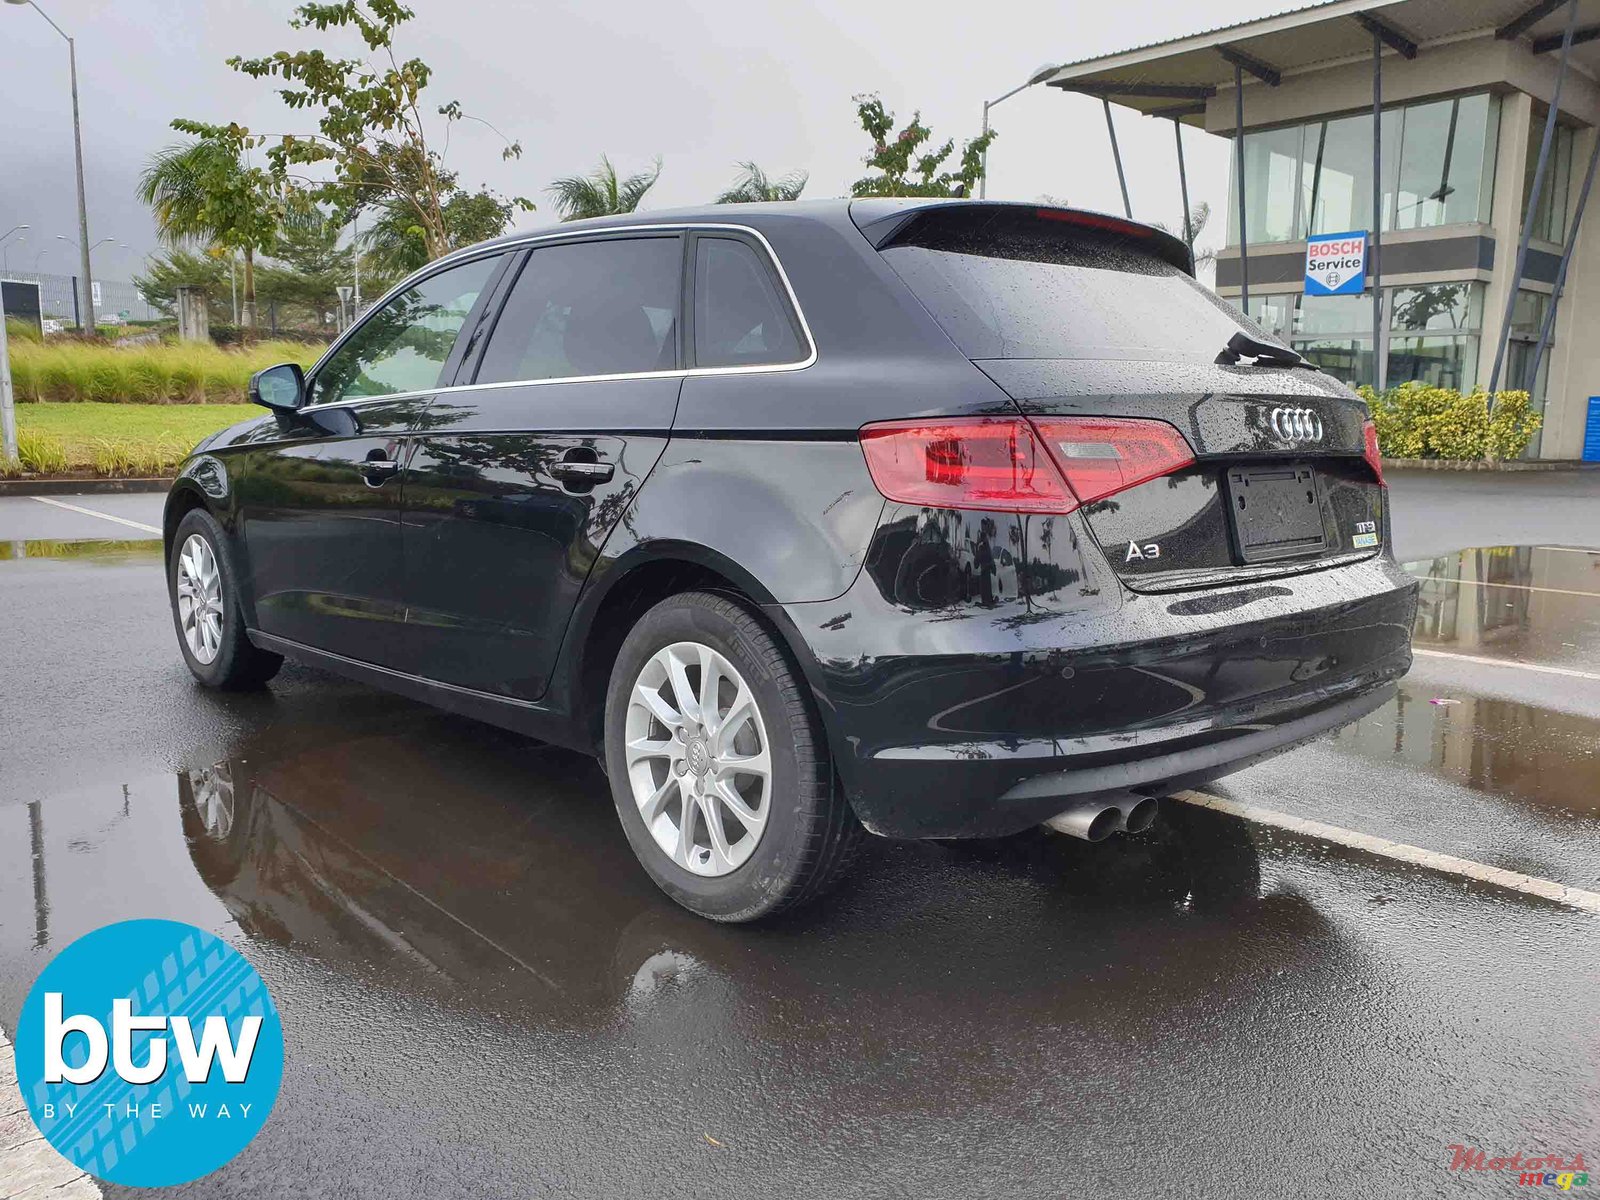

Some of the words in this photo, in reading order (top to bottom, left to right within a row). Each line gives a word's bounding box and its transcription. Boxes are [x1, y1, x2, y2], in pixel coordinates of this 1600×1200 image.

[1309, 241, 1362, 257] BOSCH
[1308, 257, 1361, 271] Service
[1125, 540, 1160, 562] A3
